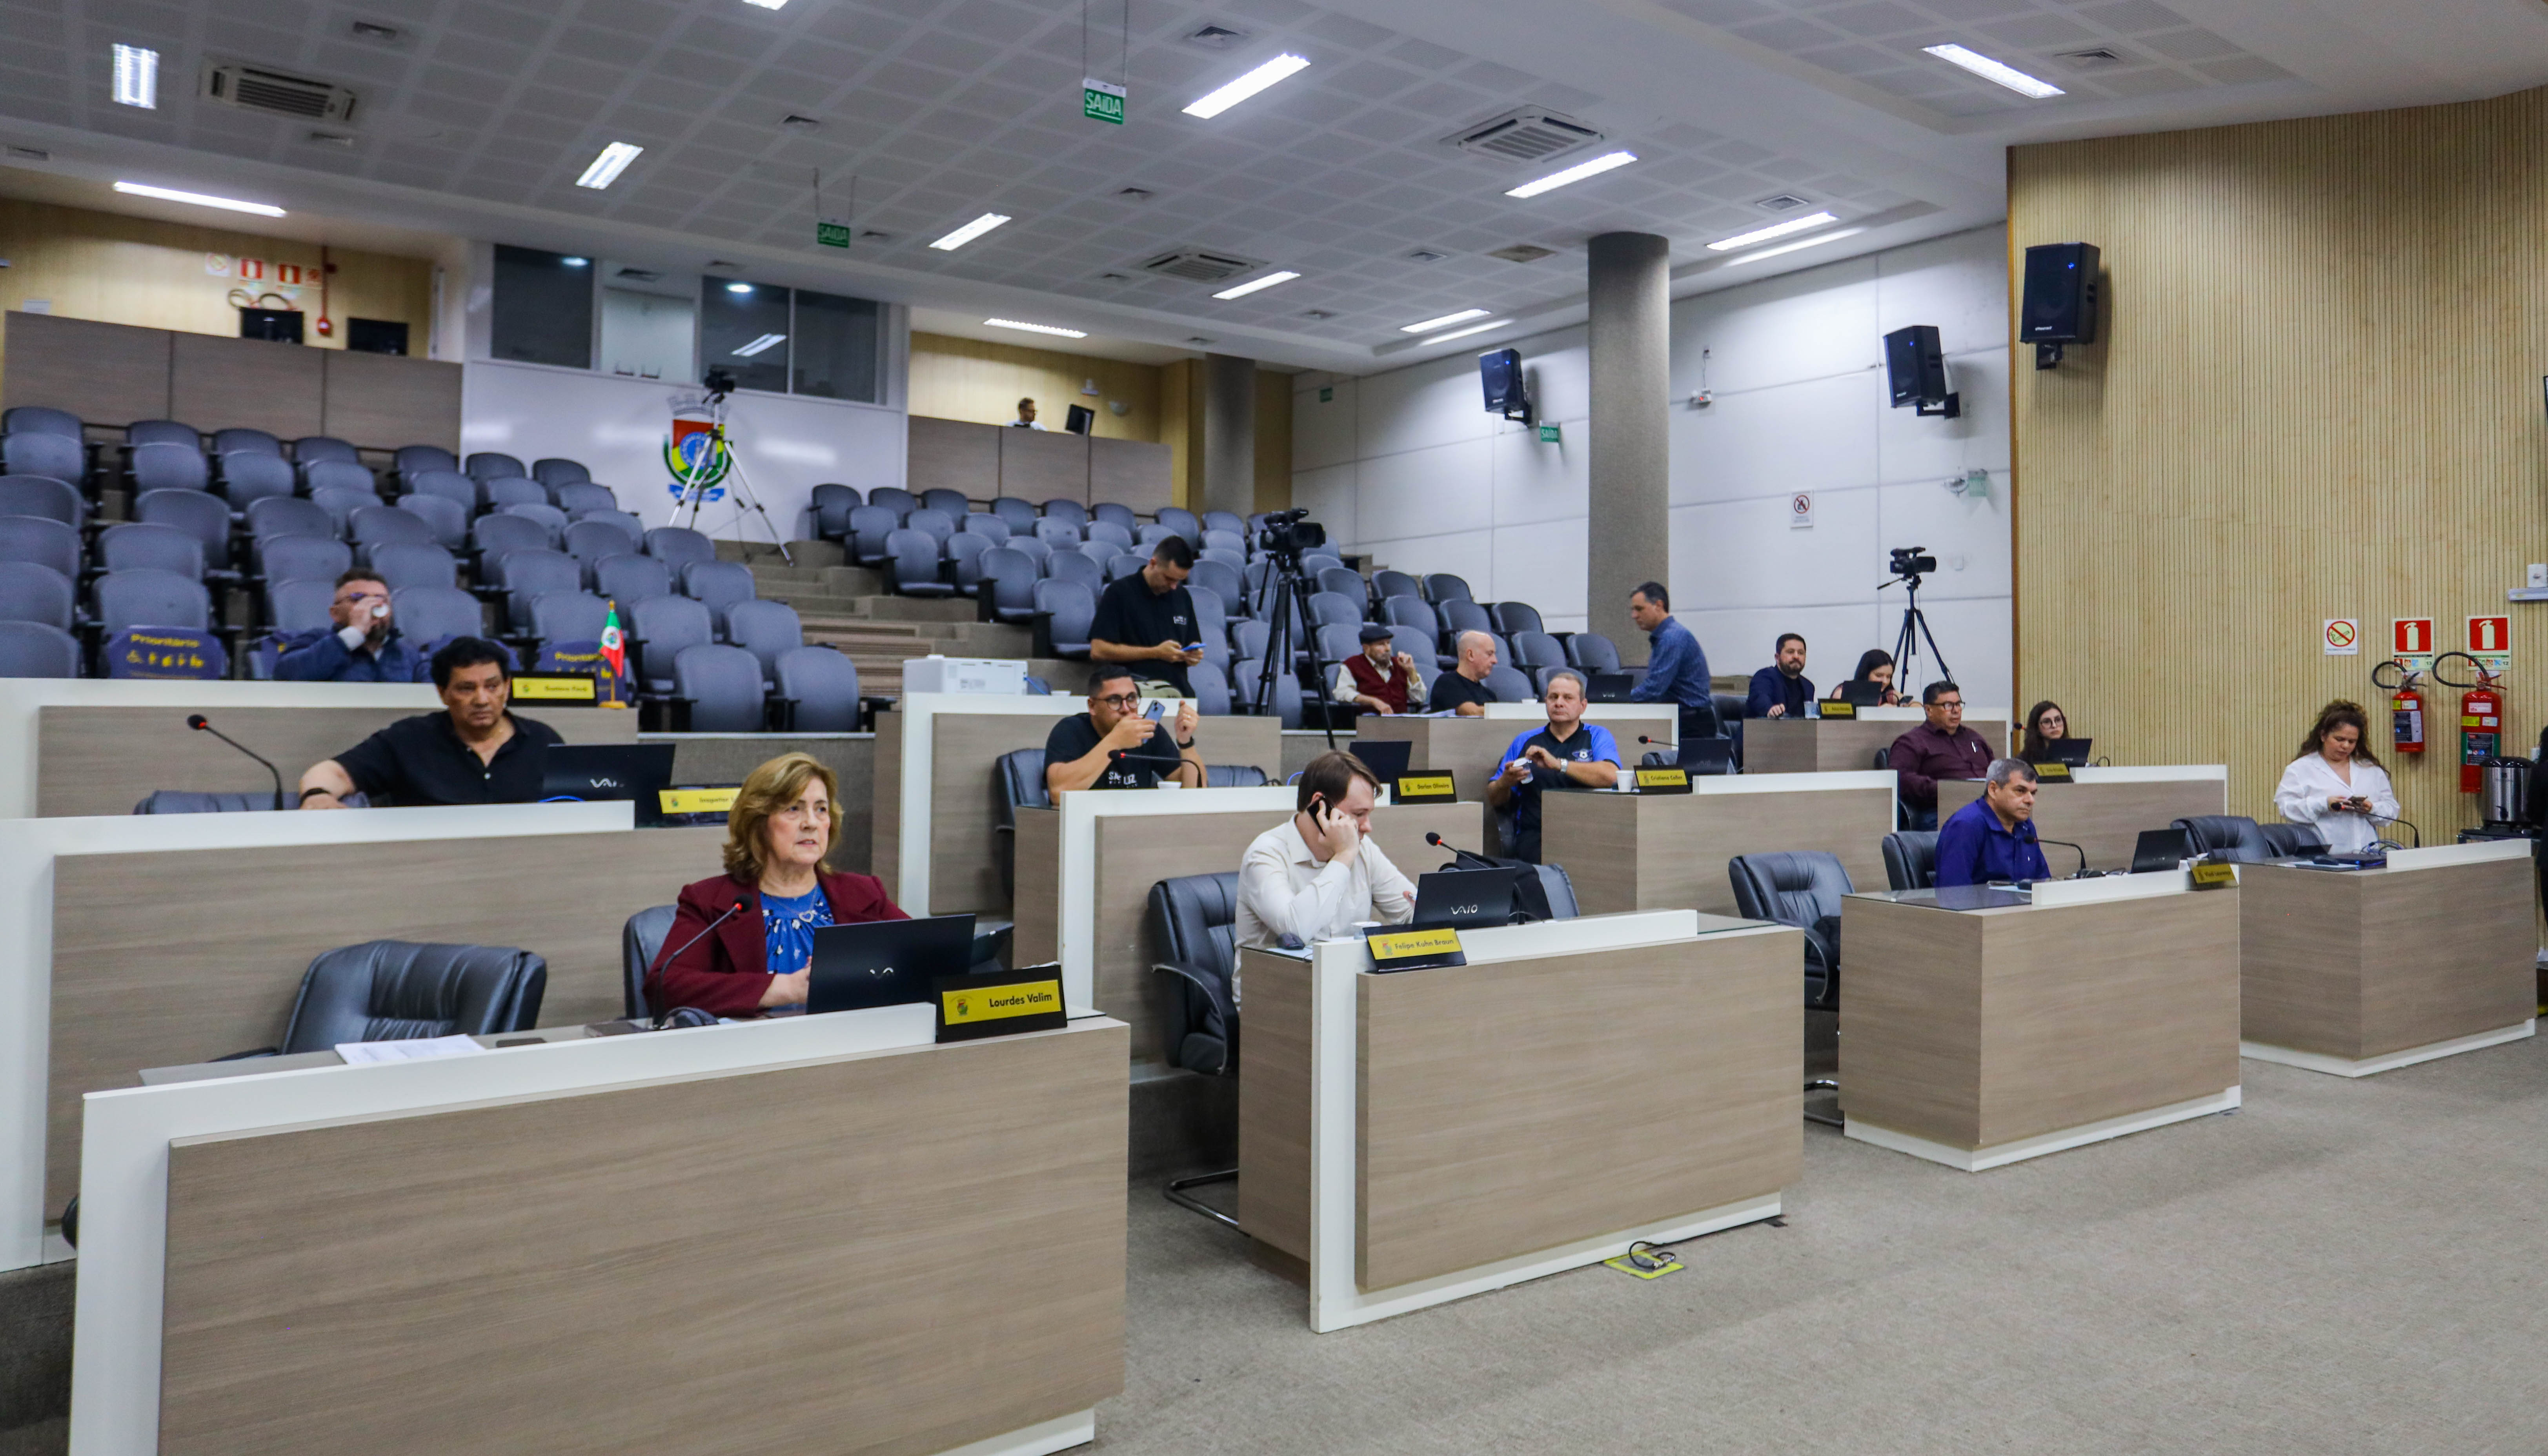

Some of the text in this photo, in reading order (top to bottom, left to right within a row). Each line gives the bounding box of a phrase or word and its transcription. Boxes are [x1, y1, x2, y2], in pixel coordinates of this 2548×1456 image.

[1451, 904, 1478, 915] VAIO
[989, 993, 1052, 1008] Lourdes Valim
